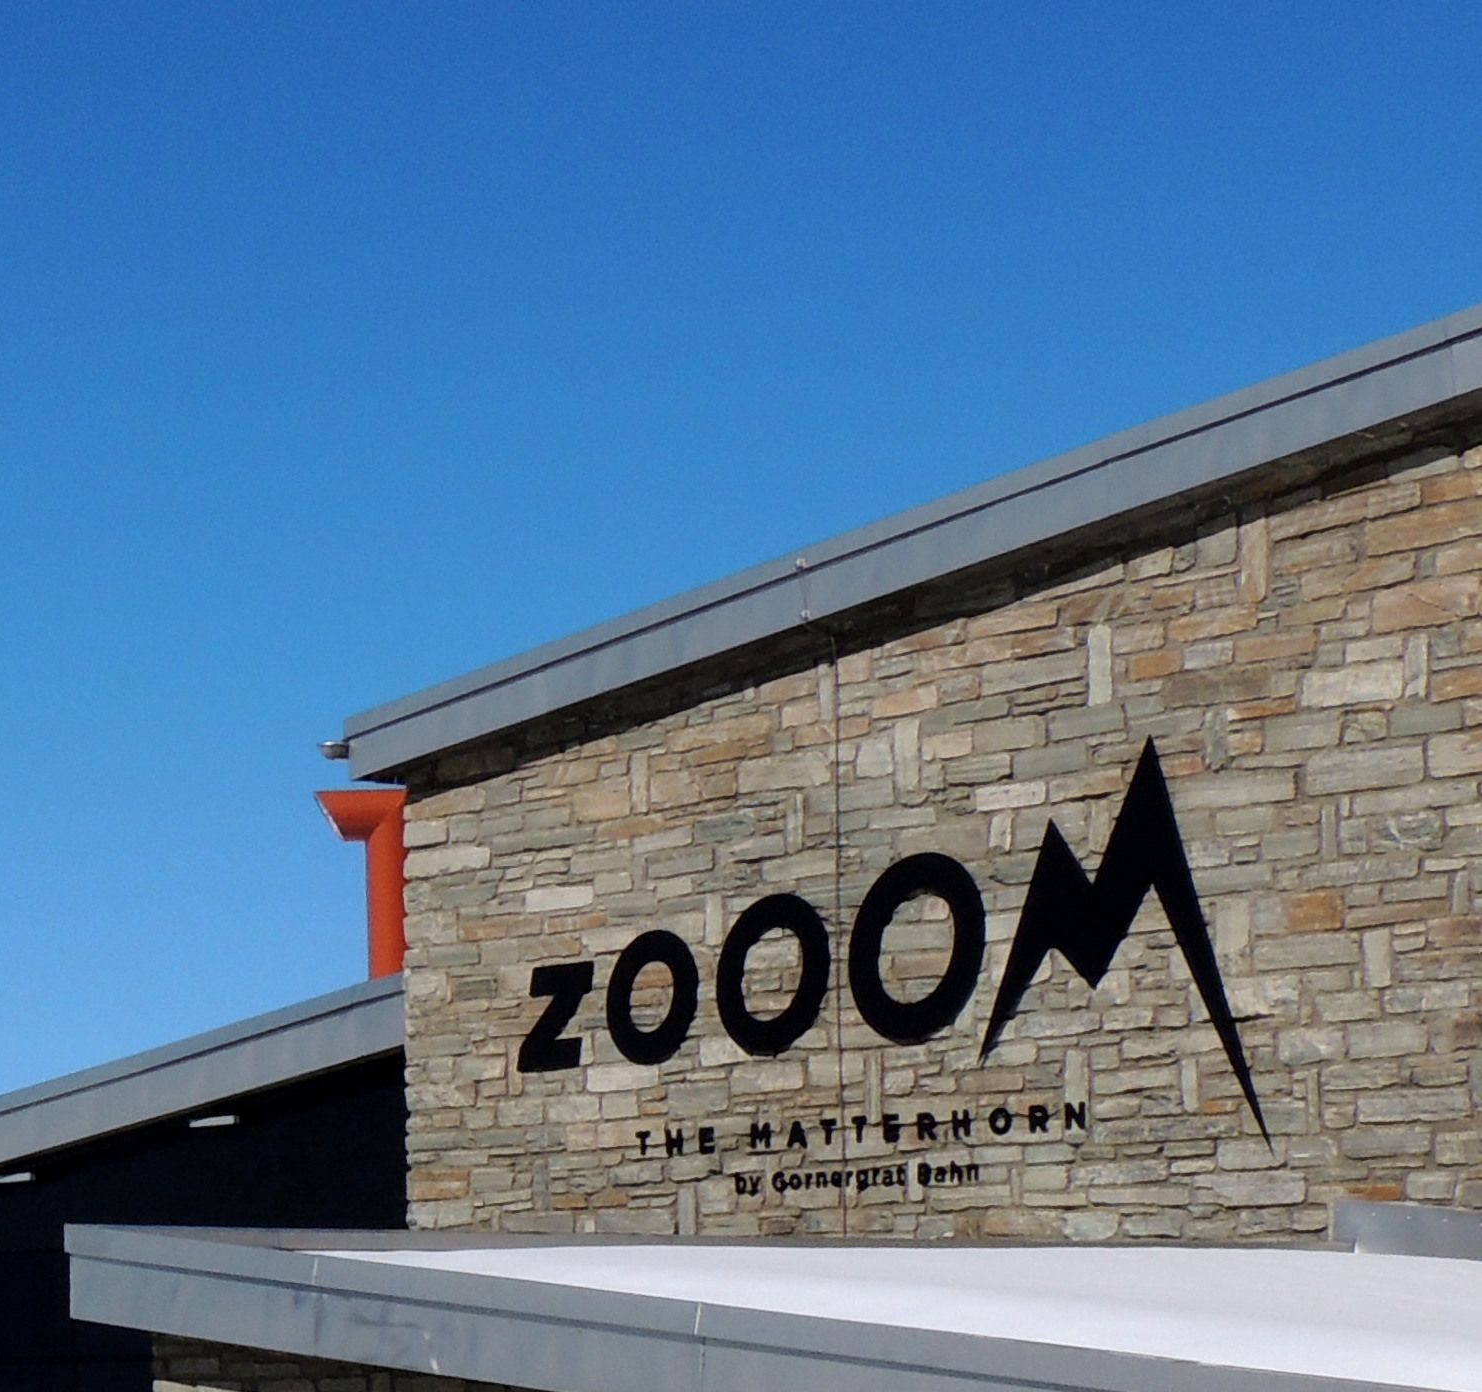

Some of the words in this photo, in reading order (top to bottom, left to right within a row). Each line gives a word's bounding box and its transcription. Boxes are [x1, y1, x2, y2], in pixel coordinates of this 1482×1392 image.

[636, 1126, 715, 1157] THE
[750, 1102, 1086, 1150] MATTERHORN
[736, 1172, 761, 1196] by
[772, 1163, 906, 1193] Gornergrat
[917, 1161, 979, 1186] Bahn
